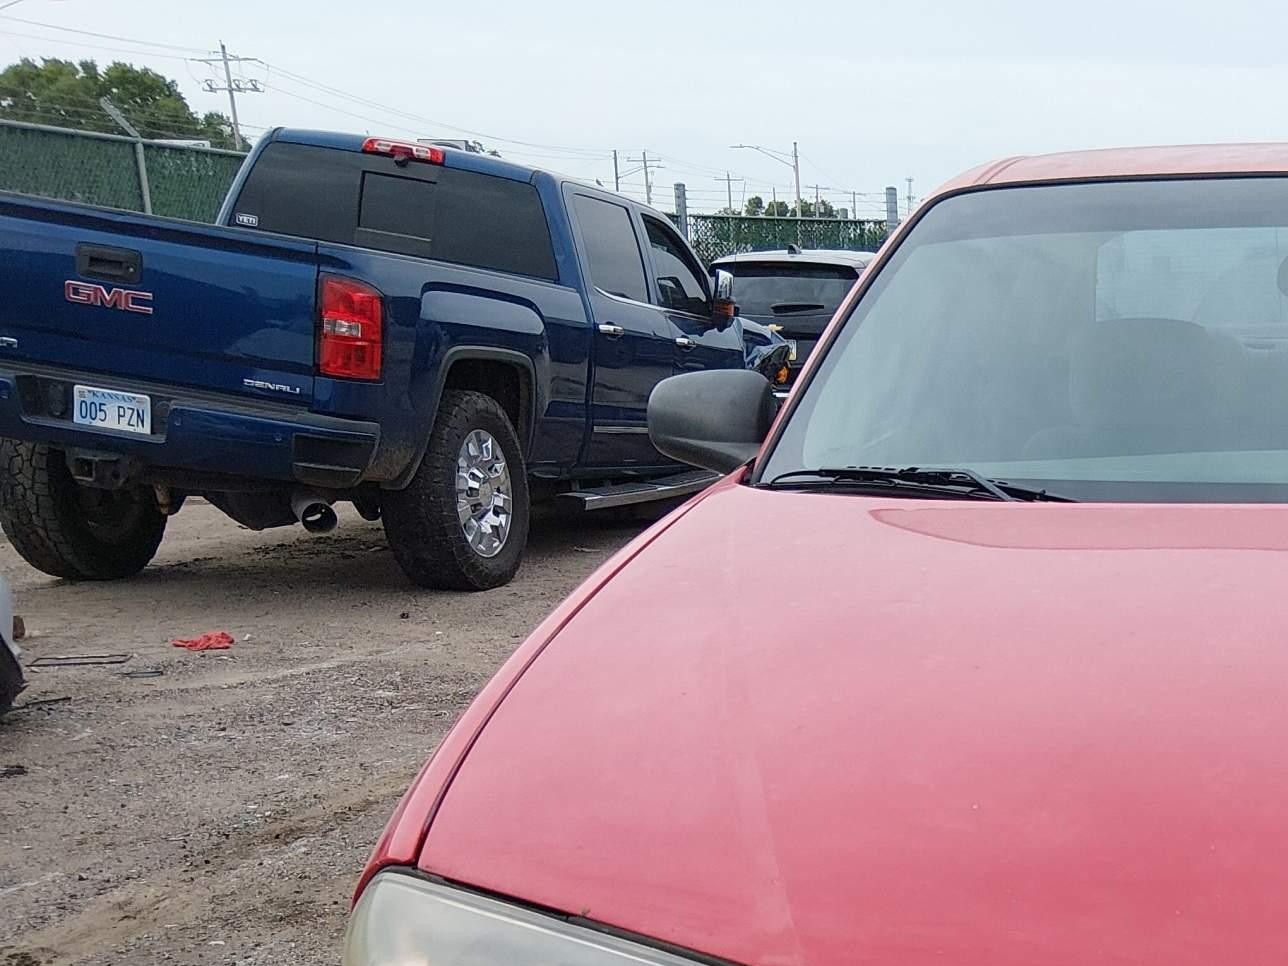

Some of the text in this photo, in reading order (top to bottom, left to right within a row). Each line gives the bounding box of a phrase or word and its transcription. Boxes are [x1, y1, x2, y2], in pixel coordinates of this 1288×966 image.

[65, 280, 154, 314] GMC
[243, 379, 300, 394] DENALI
[80, 400, 145, 429] 005 PZN
